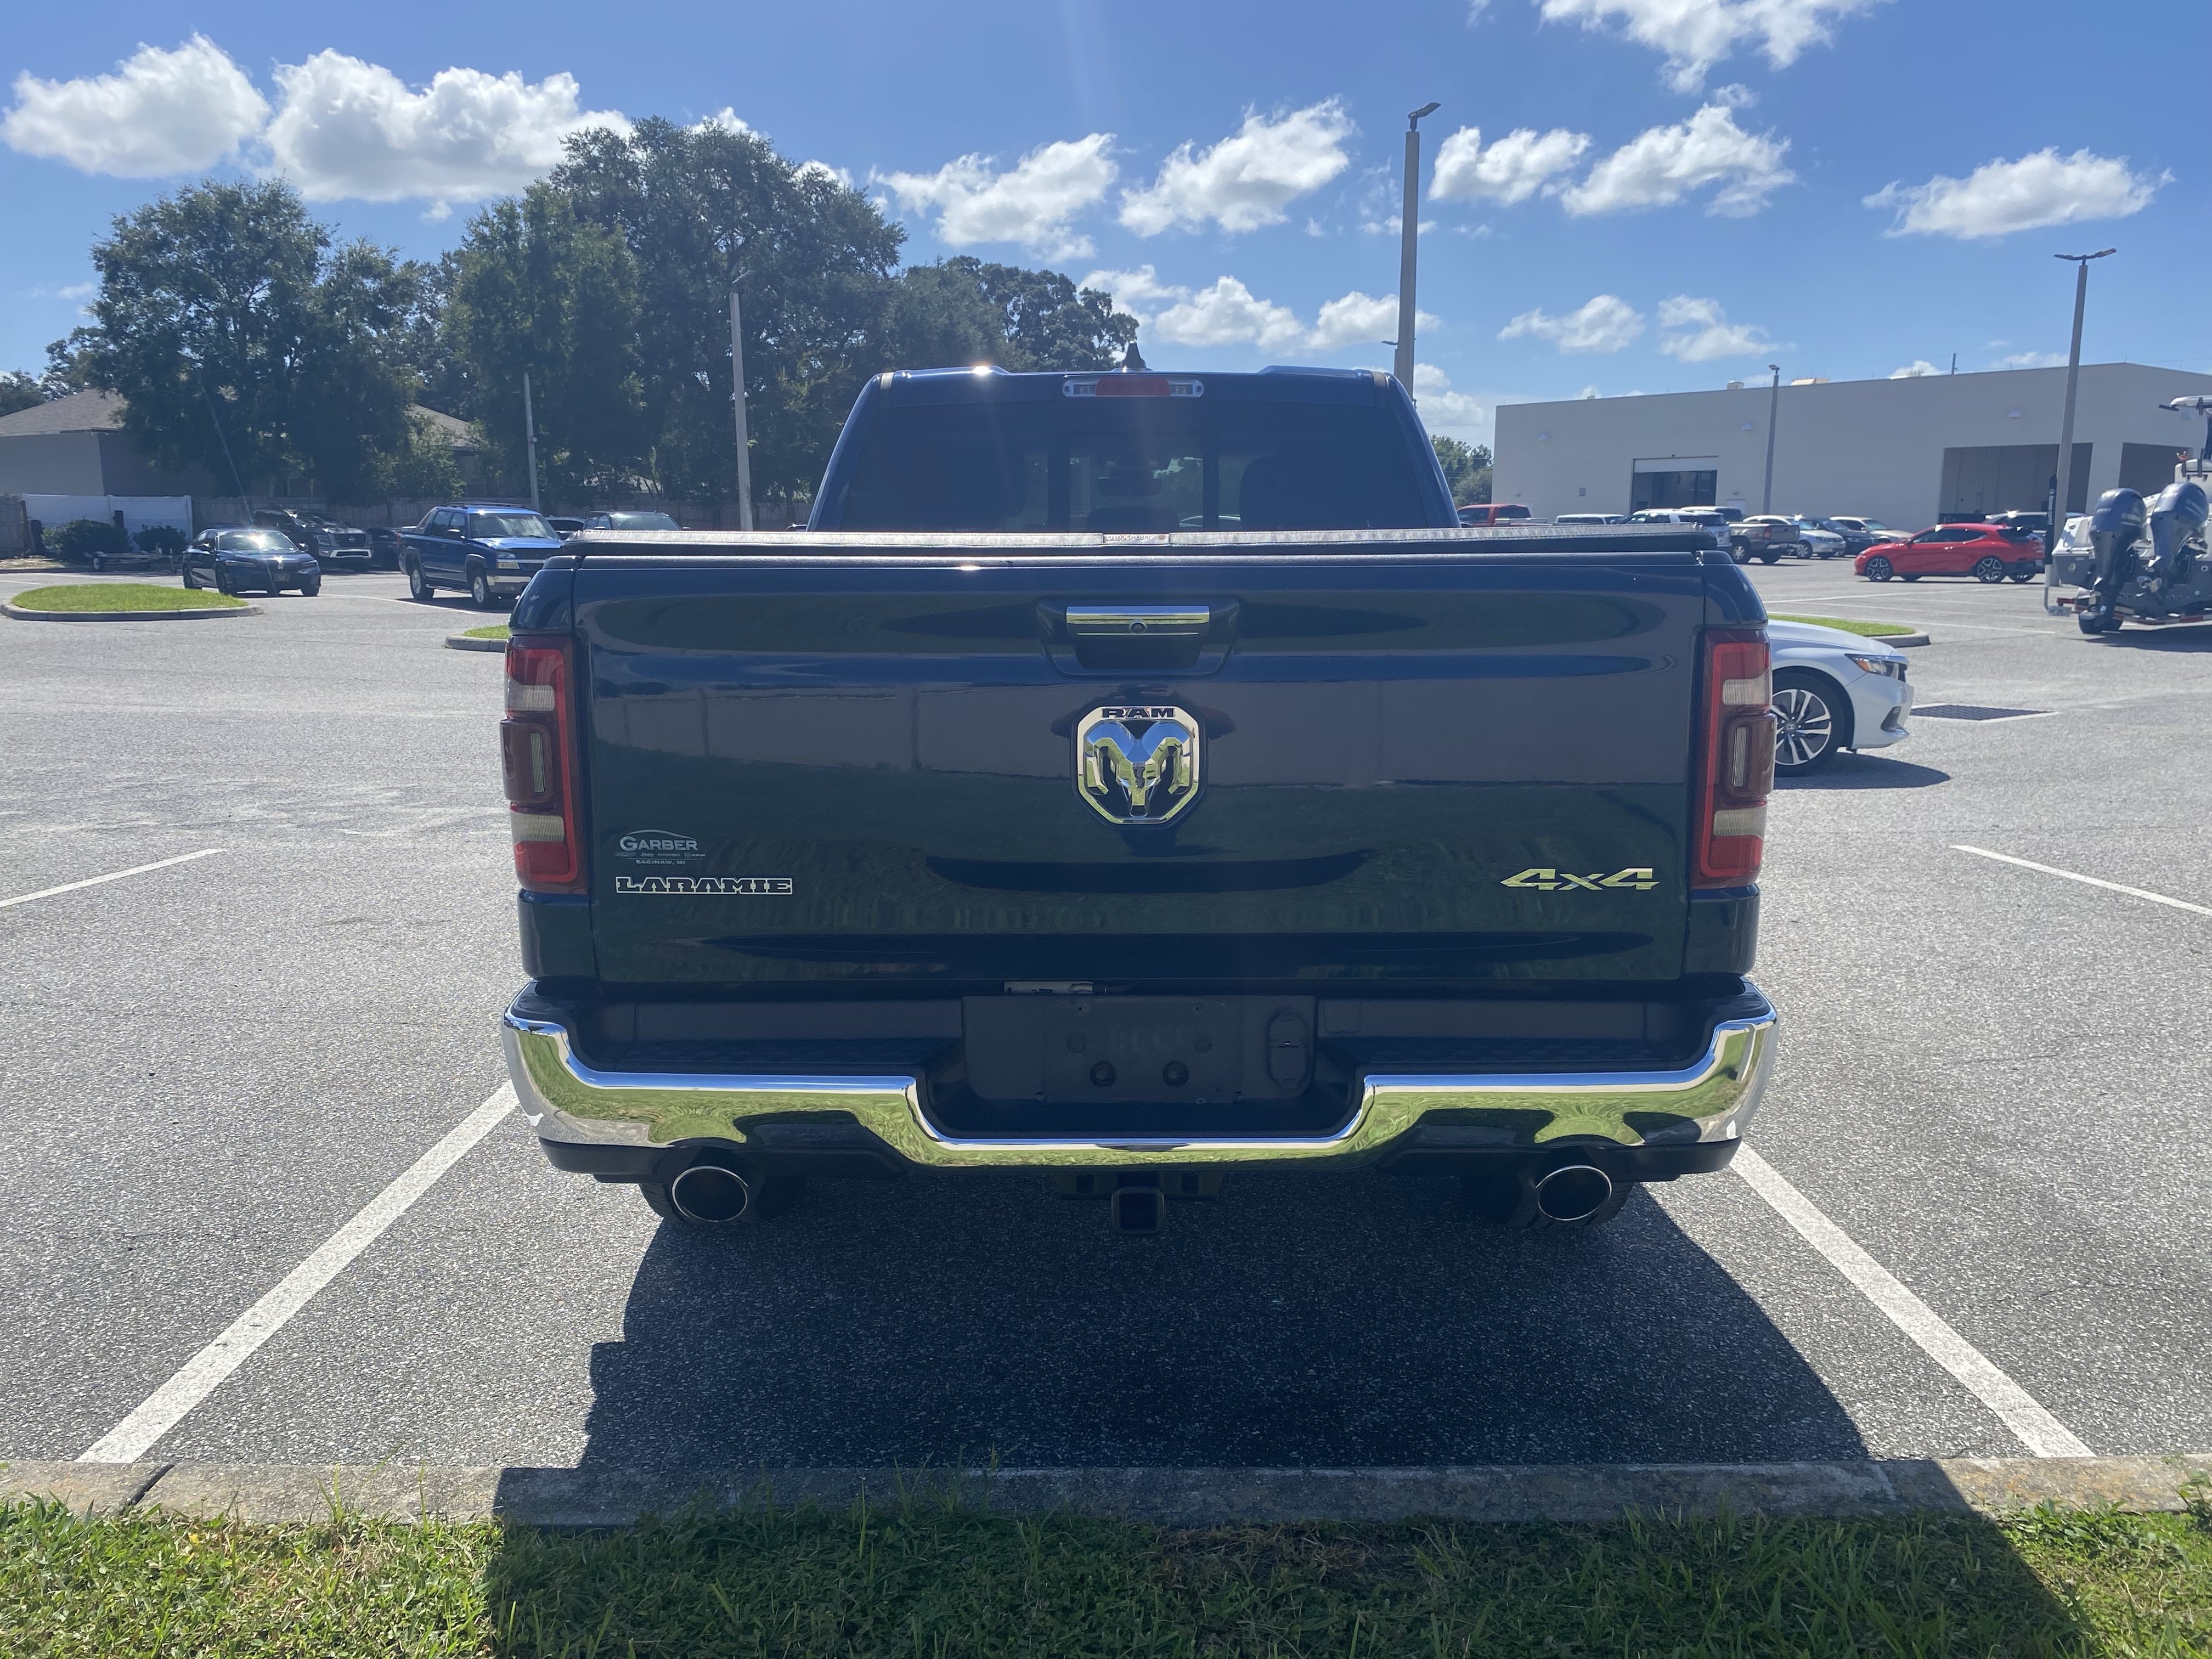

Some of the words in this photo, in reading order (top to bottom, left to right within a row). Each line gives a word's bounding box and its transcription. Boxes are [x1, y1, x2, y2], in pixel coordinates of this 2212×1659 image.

[1102, 708, 1175, 718] RAM
[619, 836, 698, 851] GARBER
[616, 876, 793, 895] LARAMIE
[1500, 868, 1660, 890] 4x4
